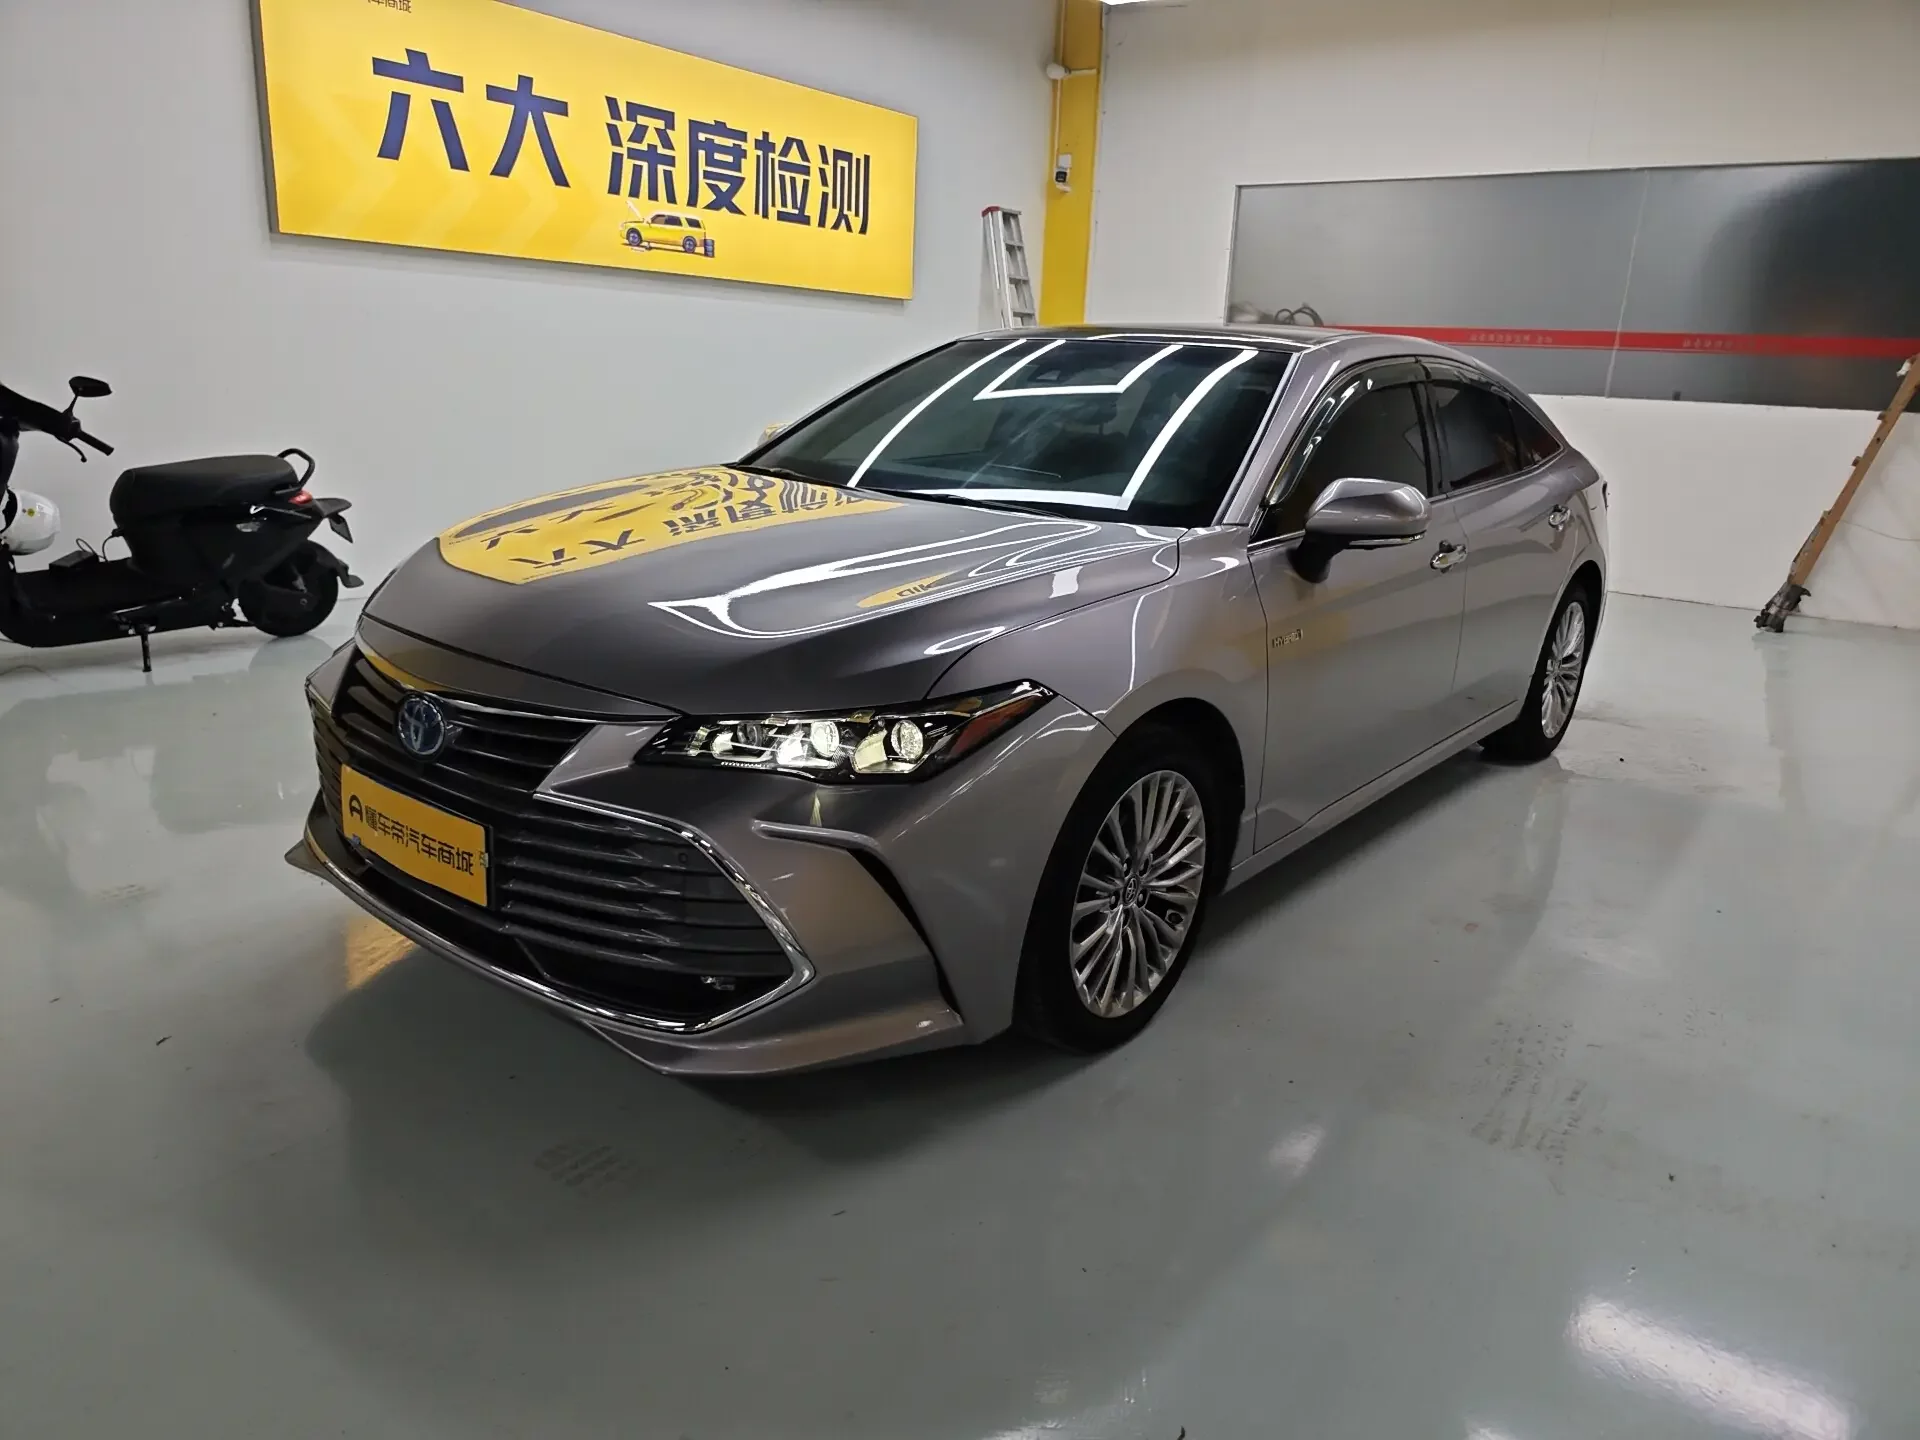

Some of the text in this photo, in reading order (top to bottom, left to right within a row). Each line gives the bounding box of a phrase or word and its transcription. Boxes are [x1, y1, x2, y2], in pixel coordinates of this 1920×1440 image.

[372, 48, 871, 235] 六大 深度检测
